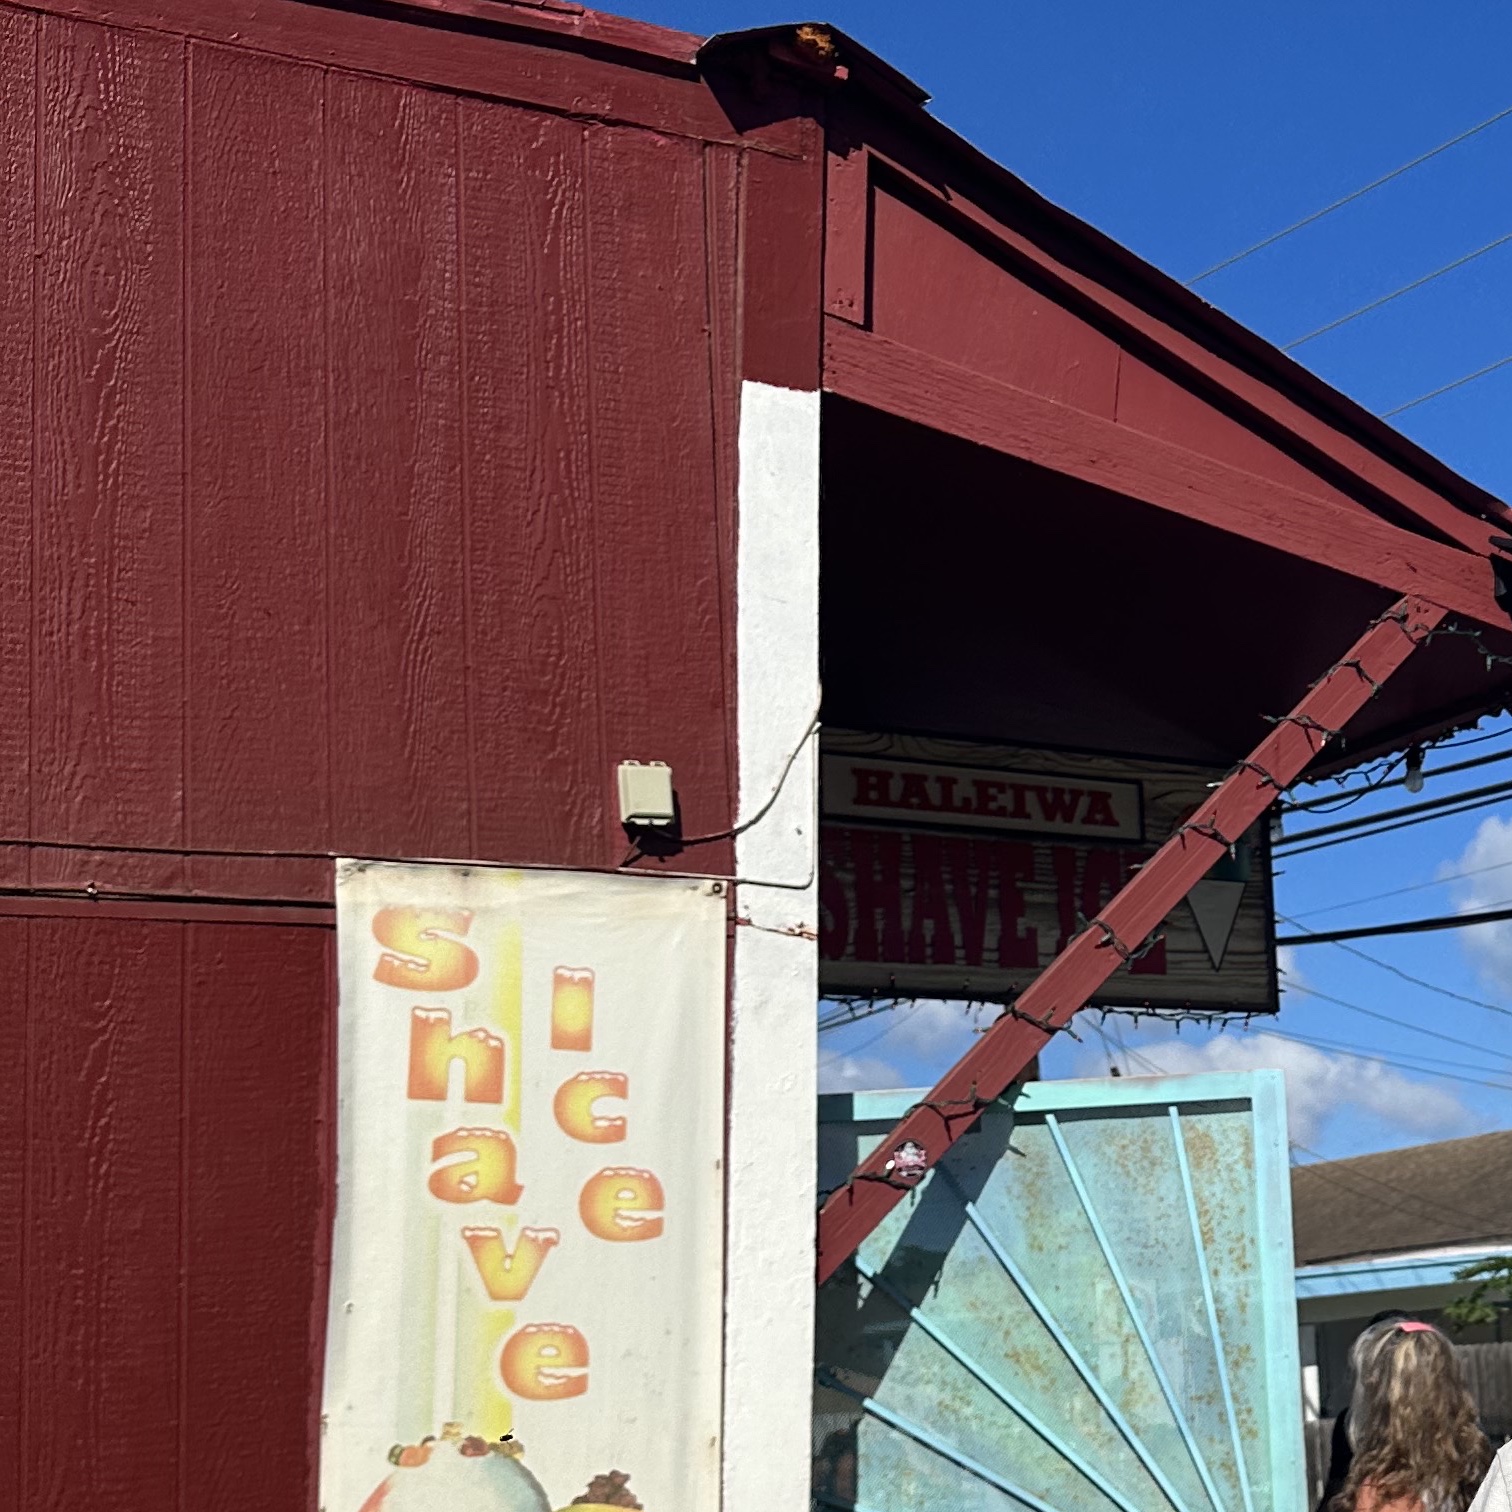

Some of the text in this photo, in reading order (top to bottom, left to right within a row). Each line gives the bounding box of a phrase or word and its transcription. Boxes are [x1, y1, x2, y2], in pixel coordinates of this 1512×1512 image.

[852, 768, 1119, 827] HALEIWA
[372, 905, 589, 1401] Shave
[551, 965, 665, 1242] Ice
